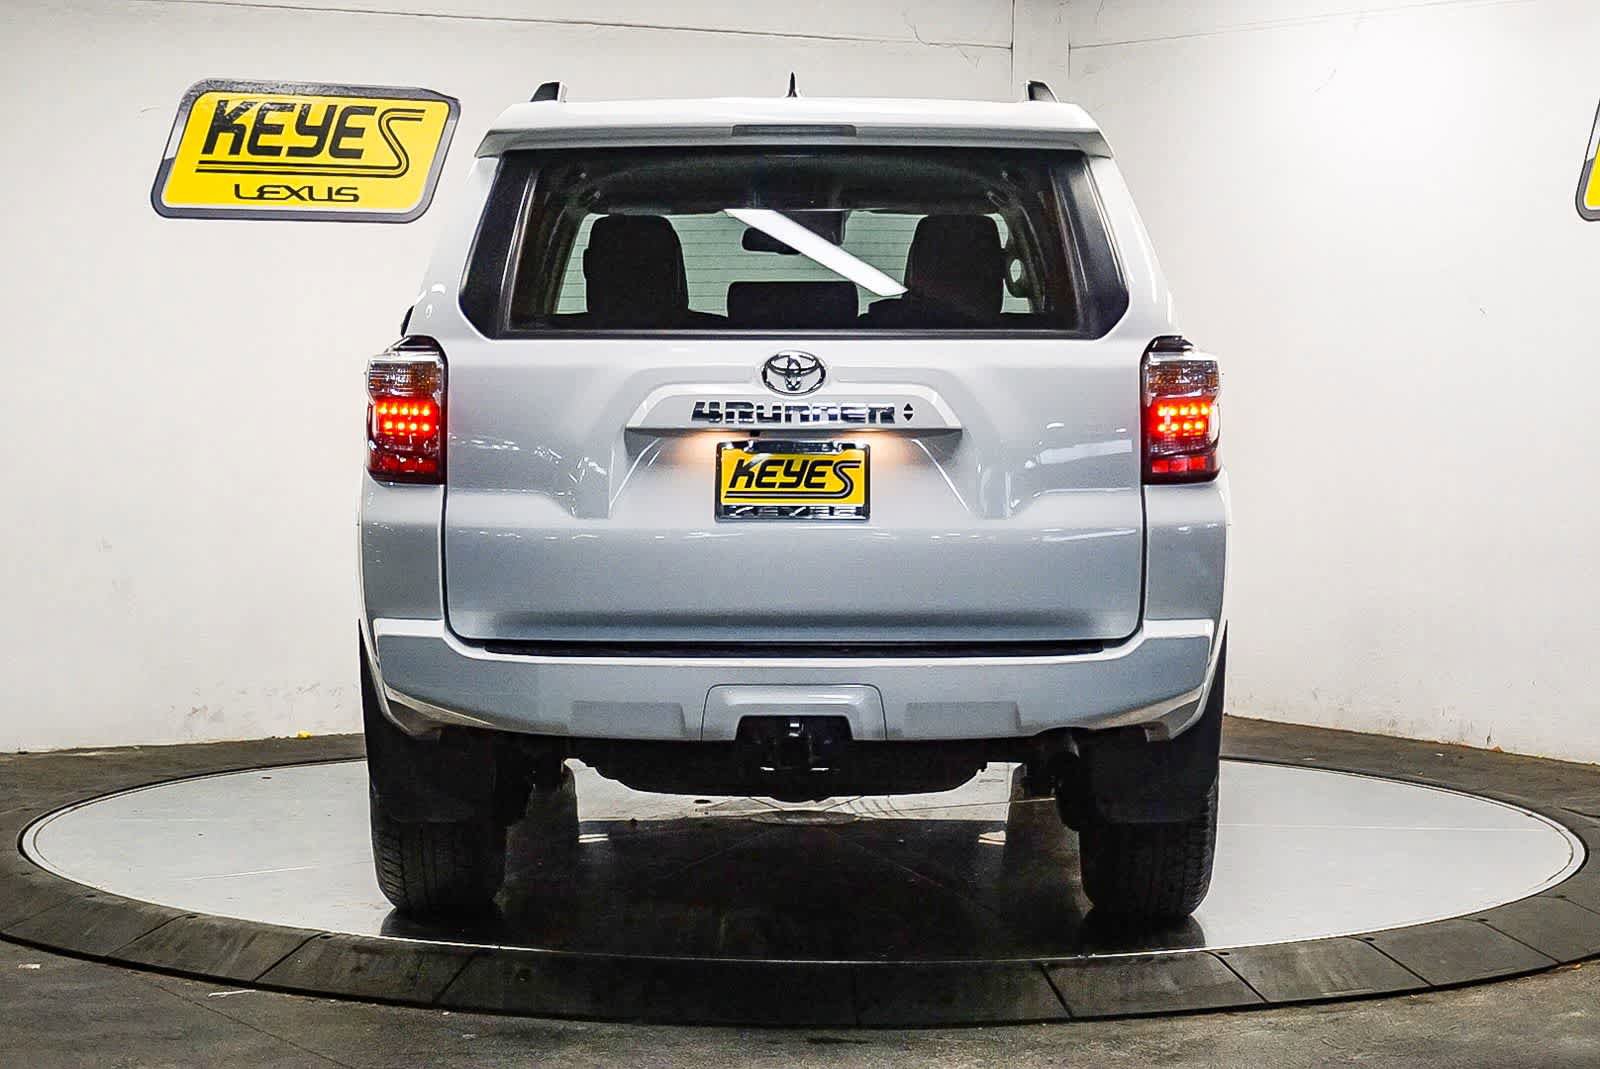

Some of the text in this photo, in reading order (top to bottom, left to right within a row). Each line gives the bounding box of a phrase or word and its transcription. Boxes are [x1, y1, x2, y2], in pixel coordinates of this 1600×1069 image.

[195, 99, 426, 178] KEYES
[234, 183, 360, 203] LEXUS
[725, 459, 861, 499] KEYES
